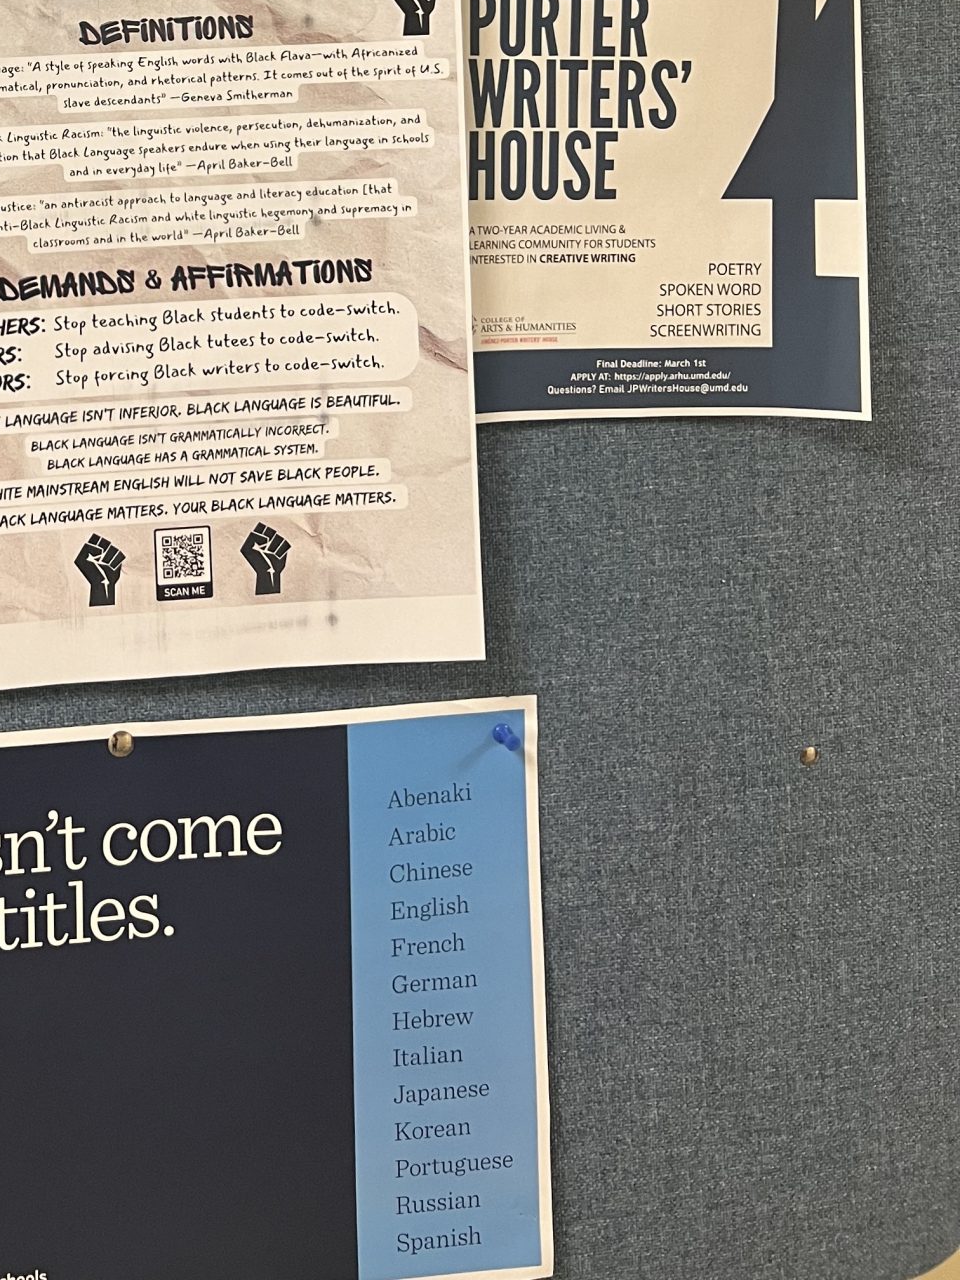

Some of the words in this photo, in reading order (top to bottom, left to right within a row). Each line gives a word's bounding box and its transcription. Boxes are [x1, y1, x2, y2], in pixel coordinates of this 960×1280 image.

[79, 14, 253, 46] DEFINITIONS
[468, 130, 618, 201] HOUSE
[145, 269, 162, 289] &
[170, 258, 372, 291] AFFIRMATIONS
[709, 263, 762, 276] POETRY
[660, 283, 713, 297] SPOKEN
[717, 283, 761, 296] WORD
[54, 316, 86, 335] Stop
[92, 313, 157, 332] teaching
[163, 308, 205, 325] Black
[211, 305, 275, 322] students
[280, 304, 295, 318] to
[300, 300, 400, 317] code-switch.
[657, 304, 703, 317] SHORT
[706, 303, 761, 316] STORIES
[650, 323, 761, 337] SCREENWRITING
[596, 360, 618, 368] Final
[620, 359, 662, 368] Deadline:
[664, 359, 691, 367] March
[694, 359, 706, 367] 1st
[547, 384, 597, 395] Questions?
[599, 384, 625, 394] Email
[627, 383, 748, 394] JPWritersHouse@umd.edu
[164, 587, 189, 597] SCAN
[191, 585, 205, 595] ME
[388, 782, 472, 809] Abenaki
[103, 814, 282, 866] come
[389, 822, 455, 846] Arabic
[390, 862, 472, 883] Chinese
[391, 894, 469, 922] English
[391, 932, 464, 957] French
[392, 974, 477, 994] German
[393, 1009, 473, 1030] Hebrew
[393, 1045, 463, 1067] Italian
[394, 1083, 489, 1106] Japanese
[395, 1122, 470, 1141] Korean
[396, 1155, 513, 1178] Portuguese
[396, 1191, 480, 1215] Russian
[397, 1225, 481, 1255] Spanish
